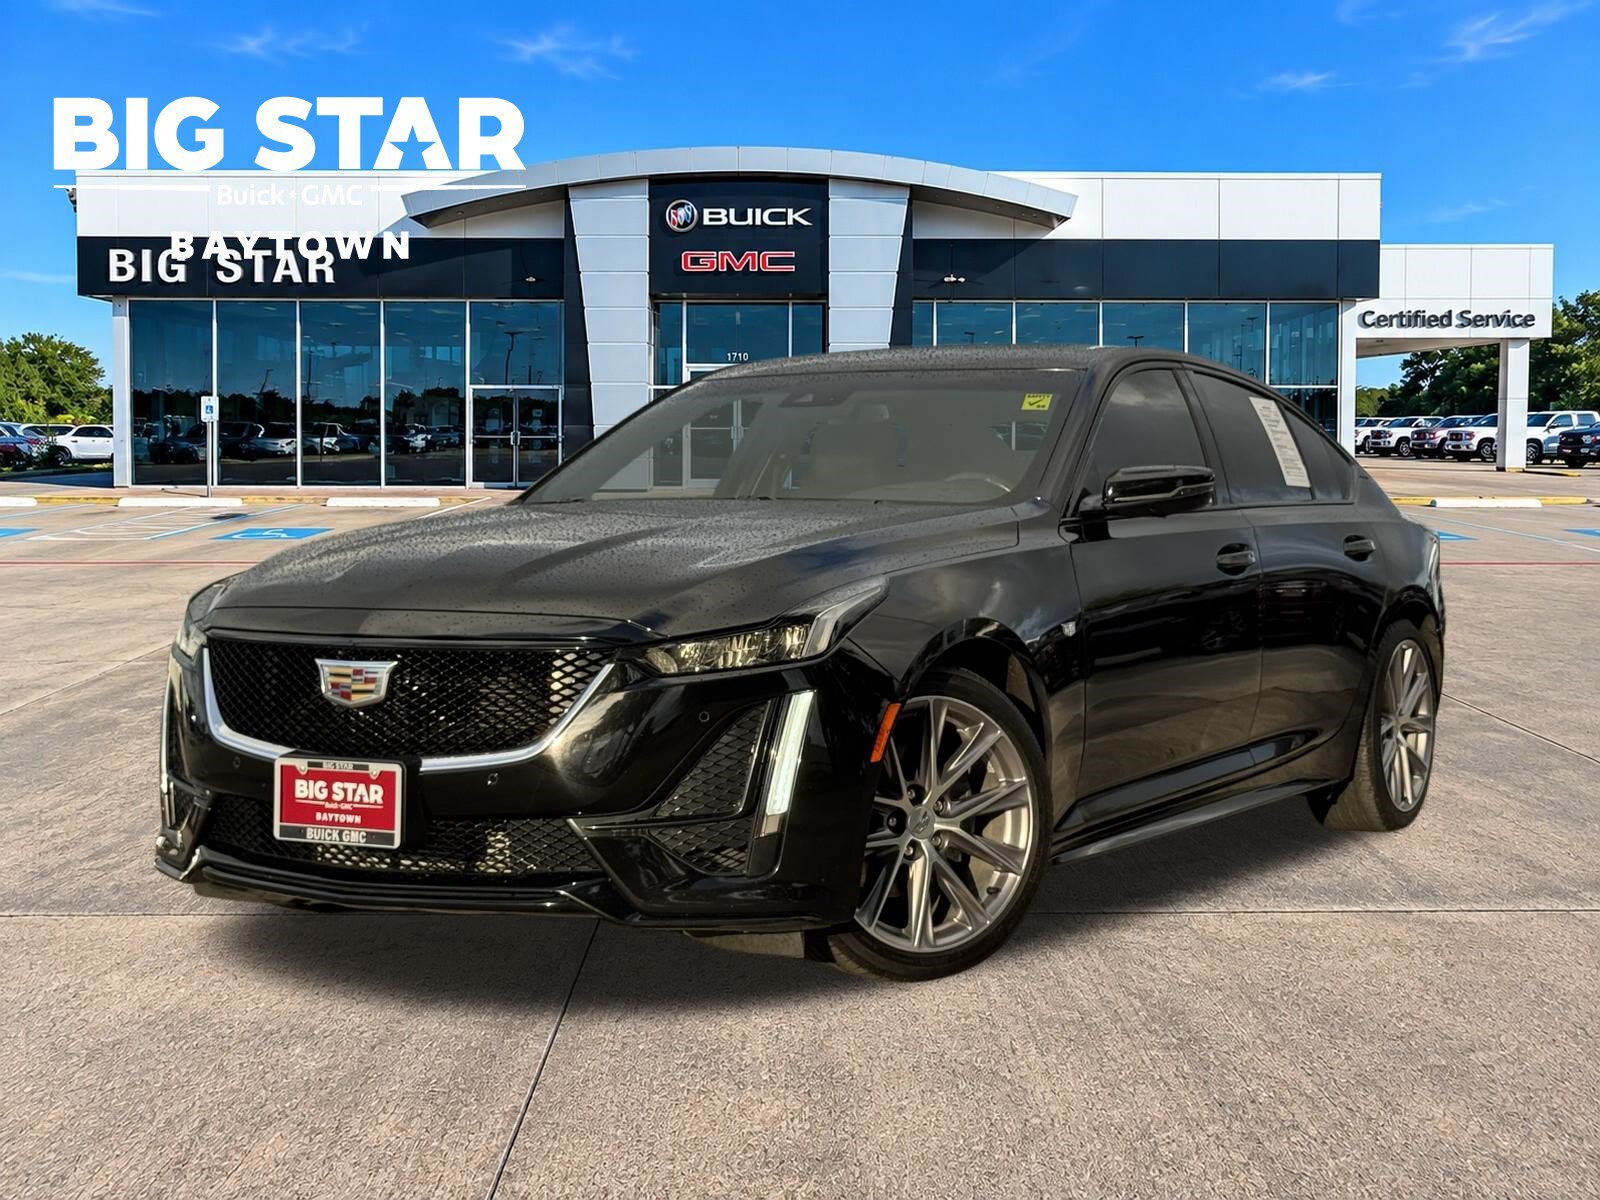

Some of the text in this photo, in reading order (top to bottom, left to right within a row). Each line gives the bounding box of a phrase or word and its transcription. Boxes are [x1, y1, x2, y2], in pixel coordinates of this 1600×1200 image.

[703, 207, 813, 226] BUICK
[108, 249, 336, 283] BIG STAR
[681, 250, 796, 272] GMC
[1358, 310, 1536, 329] Certified Service
[727, 352, 749, 362] 1710
[295, 779, 384, 804] BIG STAR
[315, 812, 361, 824] BAYTOWN
[306, 827, 367, 843] BUICK GMC
